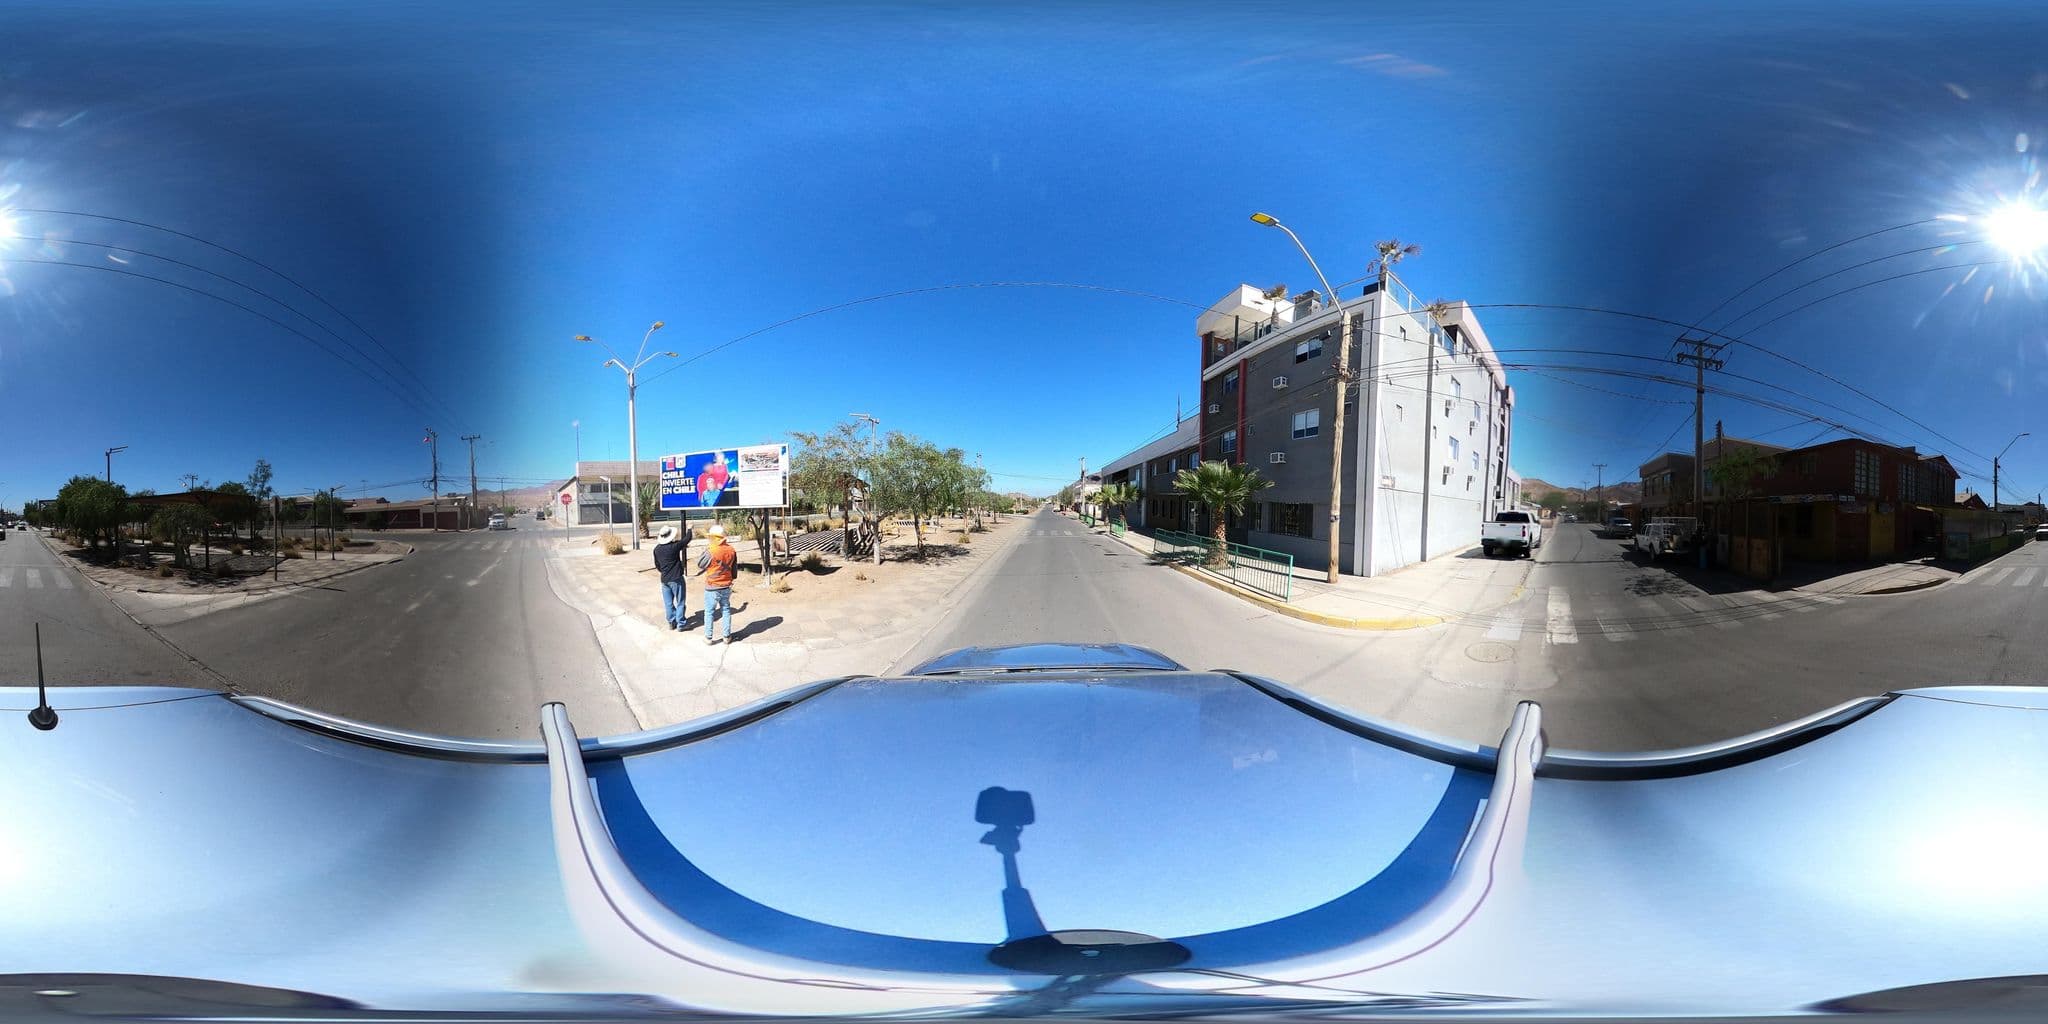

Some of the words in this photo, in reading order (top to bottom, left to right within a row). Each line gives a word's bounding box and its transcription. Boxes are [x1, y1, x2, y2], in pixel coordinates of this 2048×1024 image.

[663, 470, 684, 479] CHILE
[663, 478, 695, 487] INVIERTE
[663, 487, 672, 495] EN
[673, 486, 696, 494] CHILE
